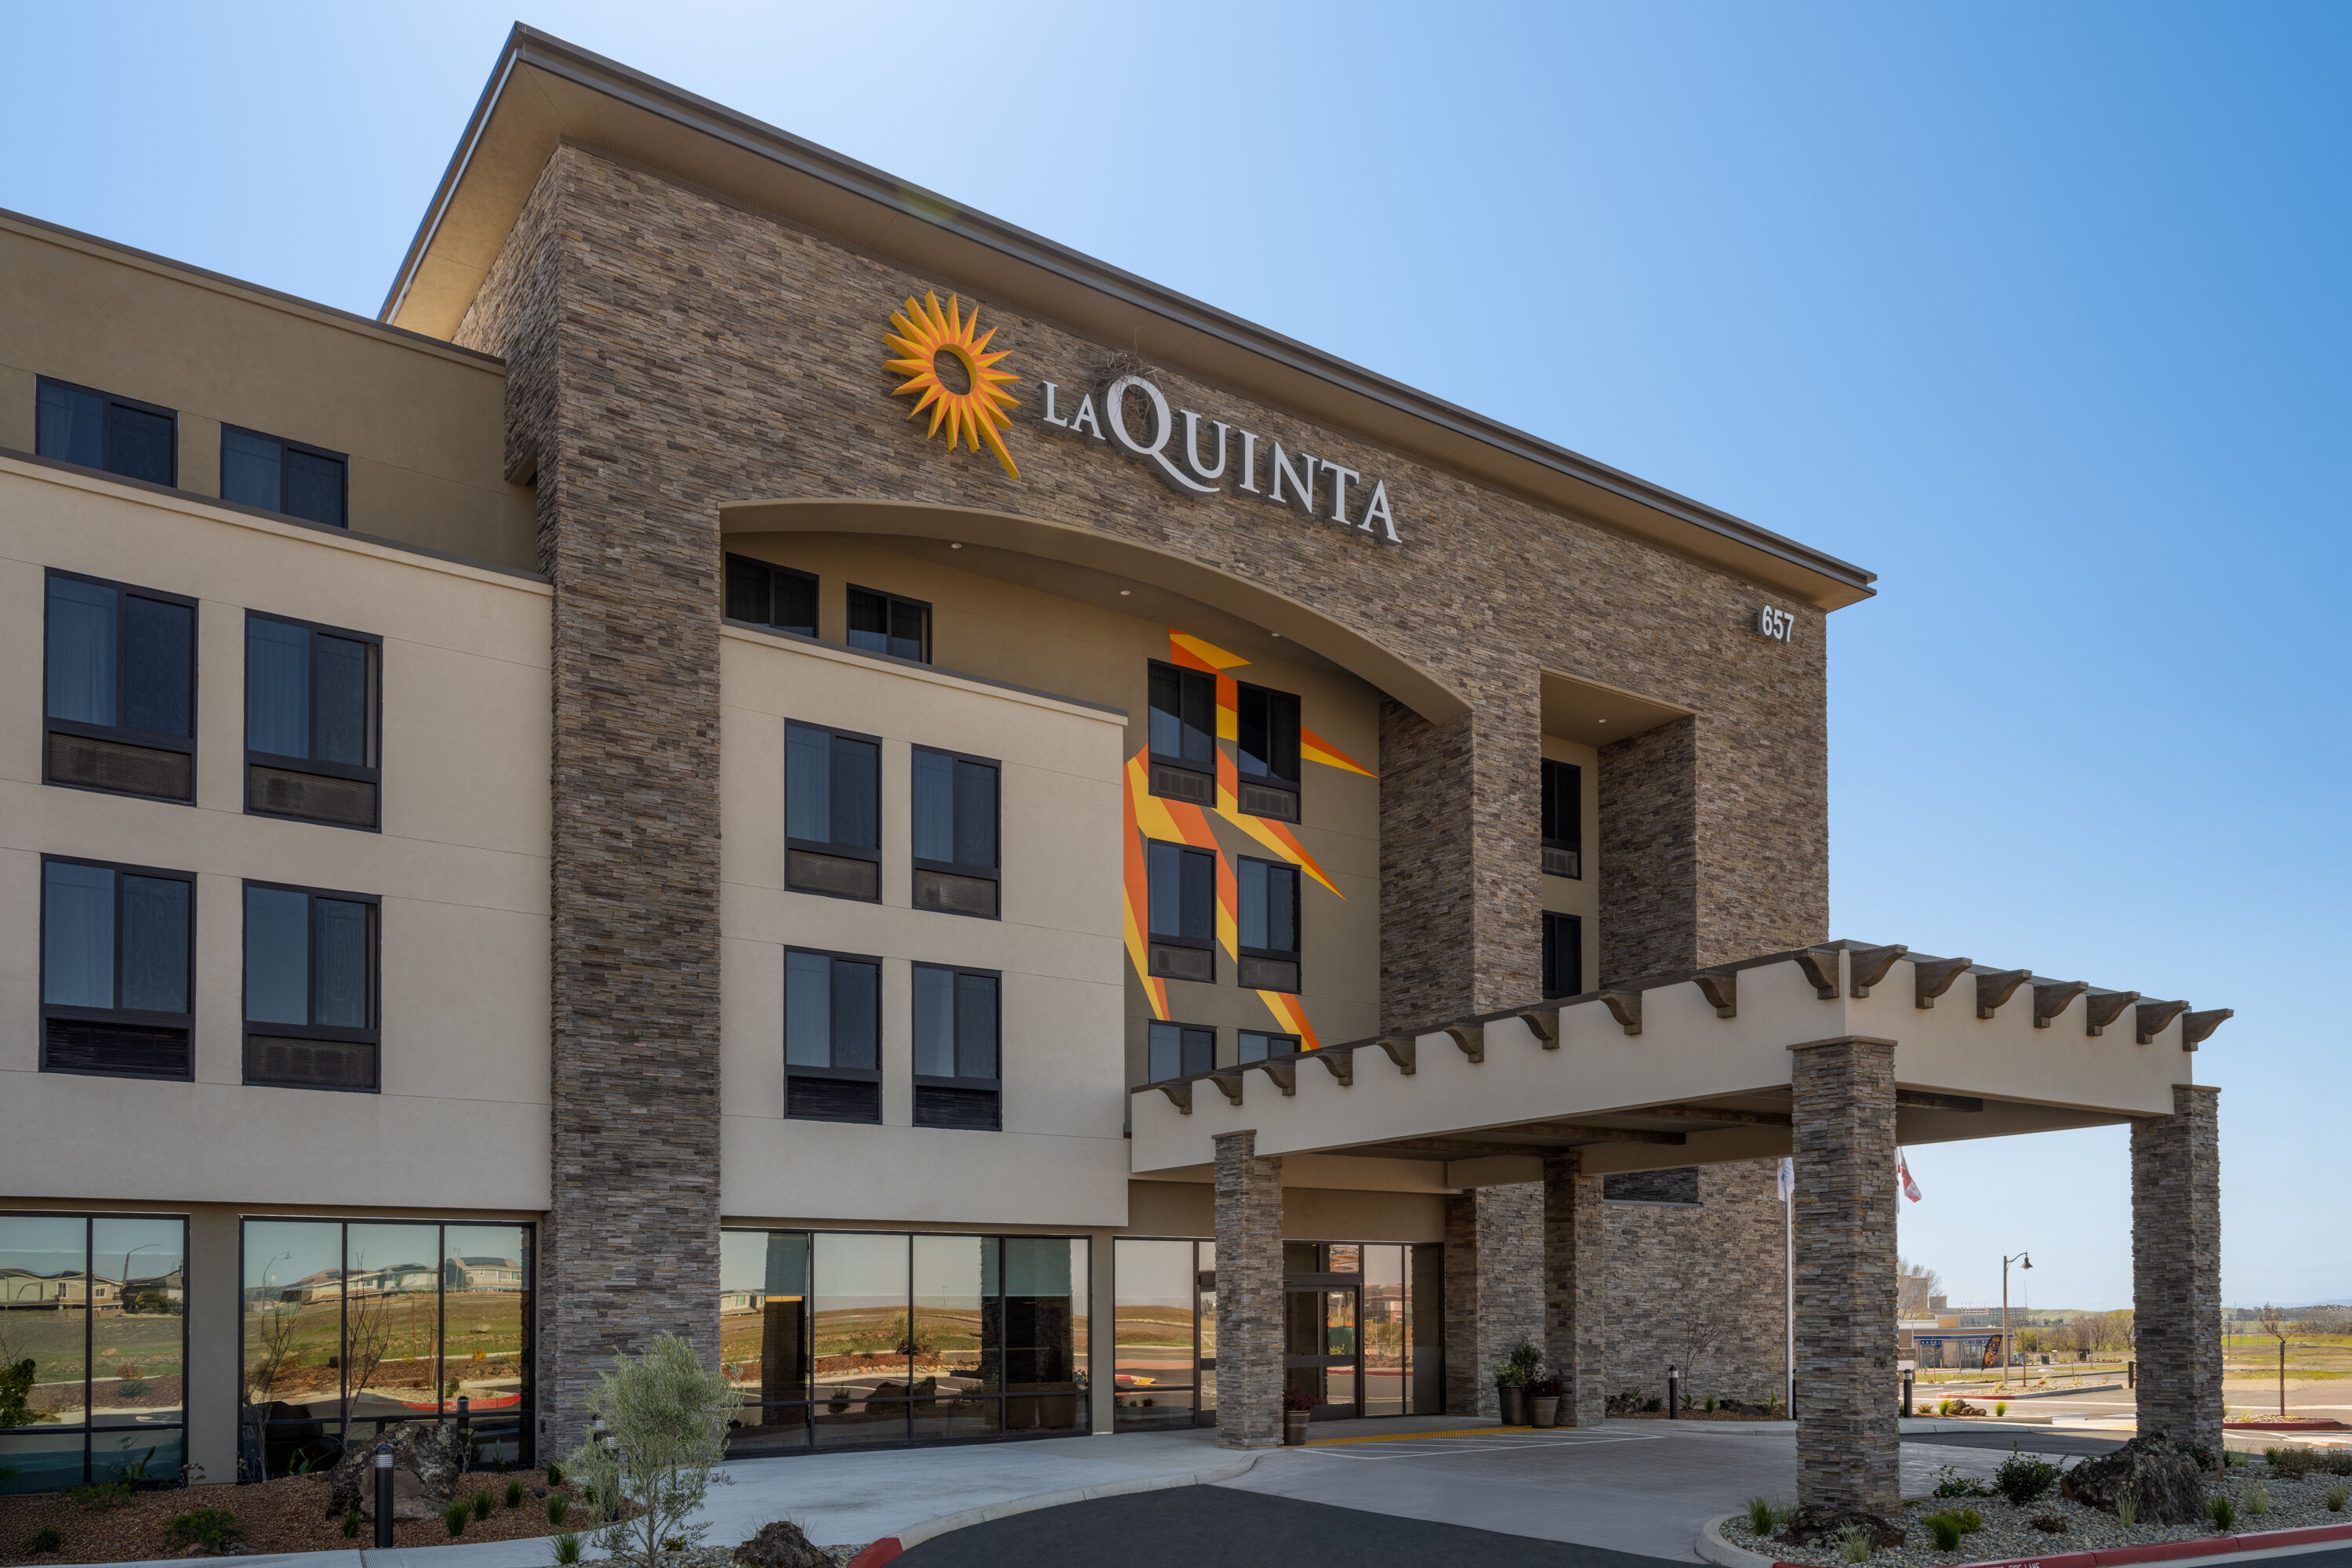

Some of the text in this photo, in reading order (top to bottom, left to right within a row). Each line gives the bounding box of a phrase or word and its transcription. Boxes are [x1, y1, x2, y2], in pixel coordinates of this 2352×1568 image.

[1040, 375, 1402, 543] LA QUINTA
[1761, 604, 1795, 642] 657
